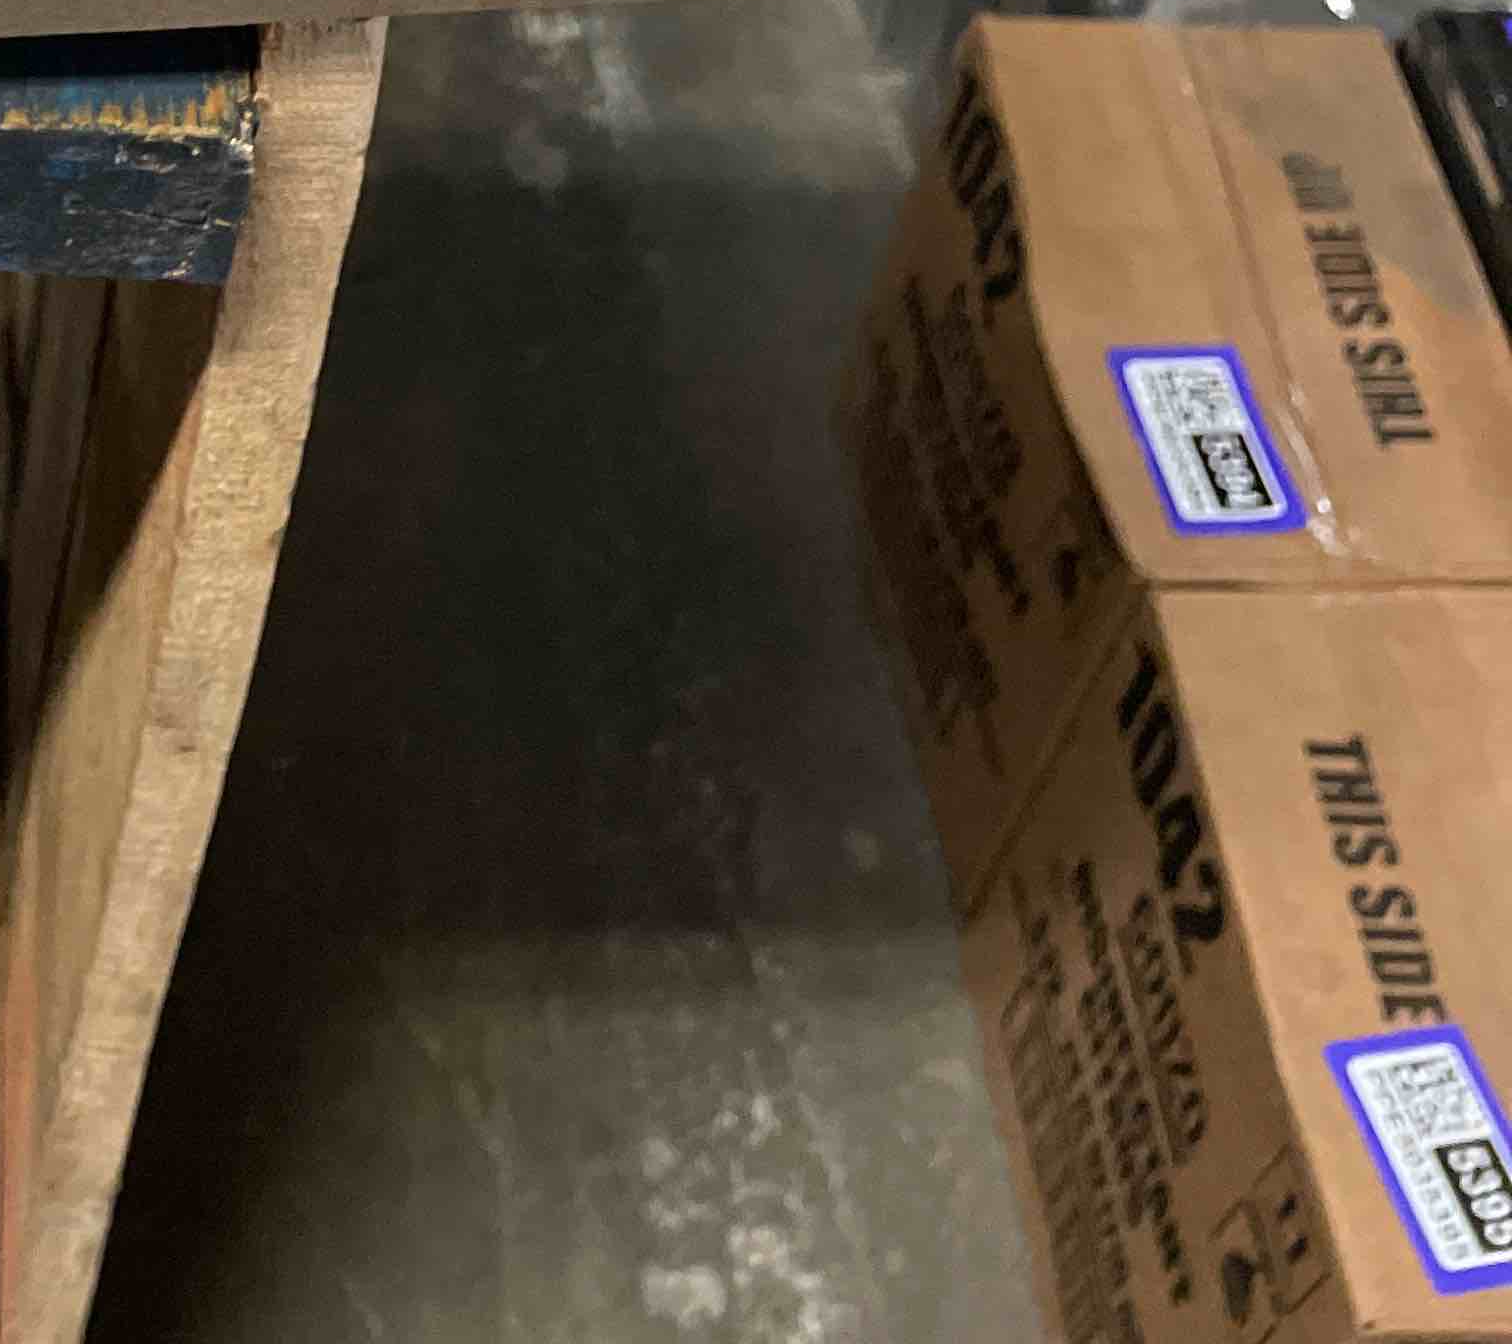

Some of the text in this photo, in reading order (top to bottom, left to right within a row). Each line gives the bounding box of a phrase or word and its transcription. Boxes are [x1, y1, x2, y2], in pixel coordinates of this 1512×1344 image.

[1305, 224, 1392, 326] SIDE
[1344, 338, 1435, 449] THIS
[1305, 734, 1398, 865] THIS
[1349, 885, 1445, 1022] SIDE
